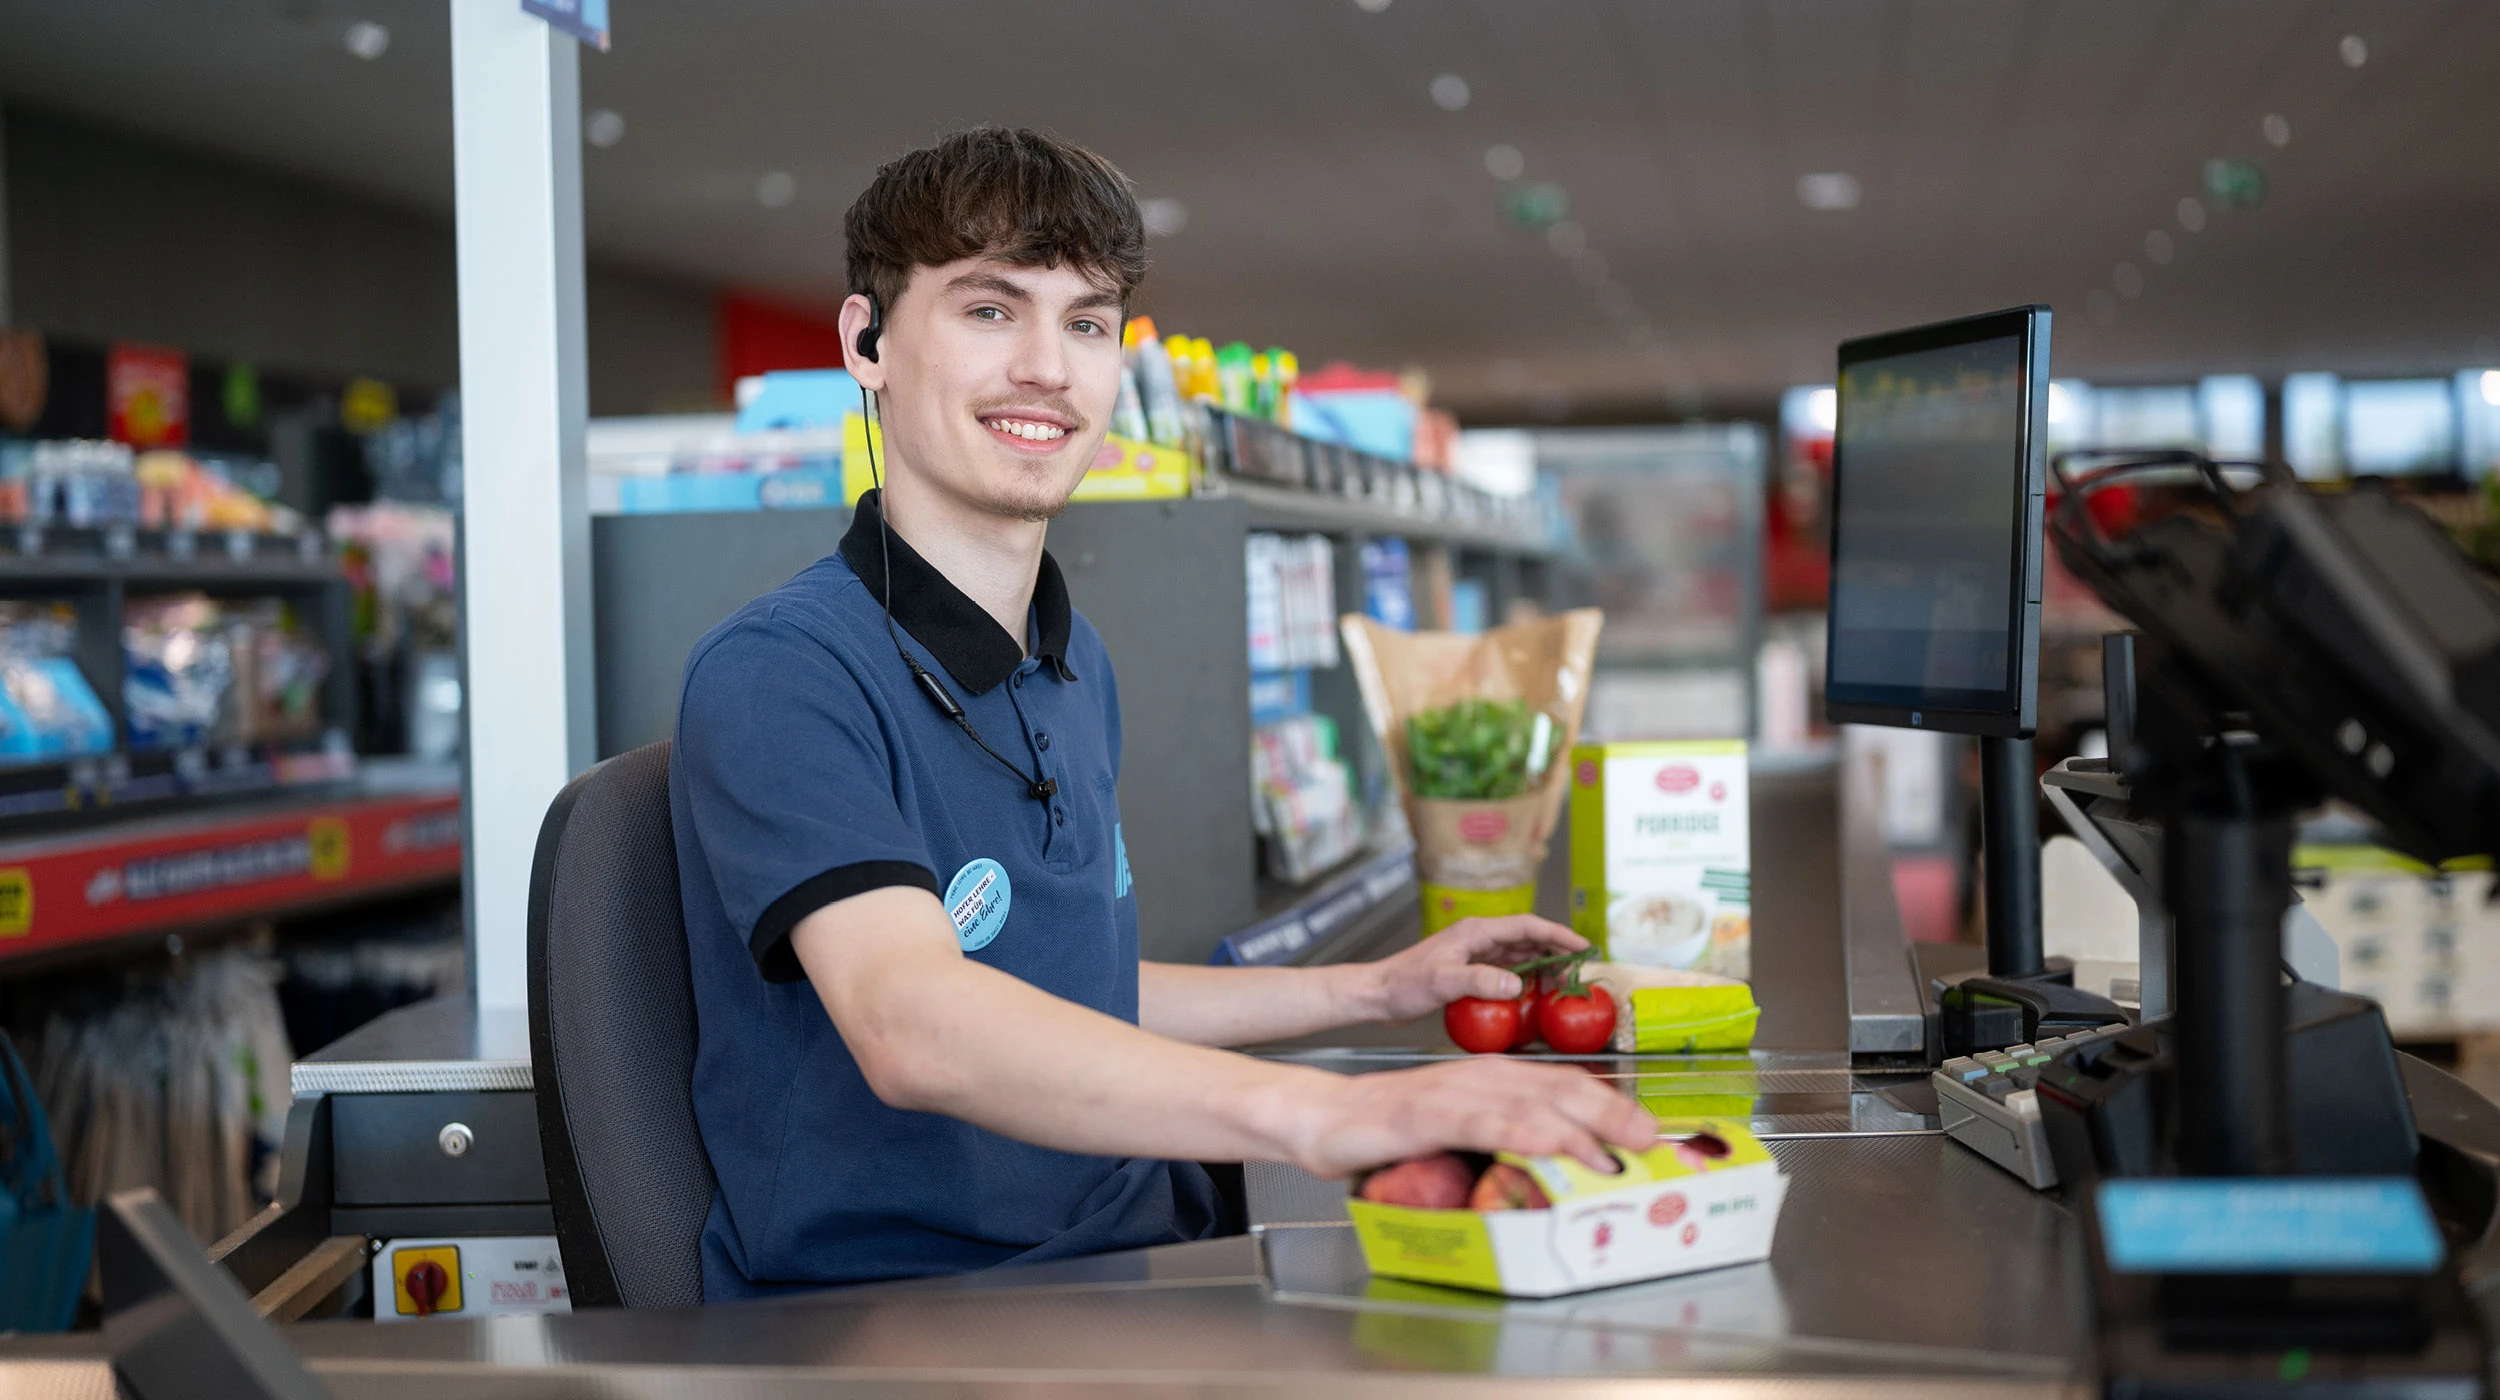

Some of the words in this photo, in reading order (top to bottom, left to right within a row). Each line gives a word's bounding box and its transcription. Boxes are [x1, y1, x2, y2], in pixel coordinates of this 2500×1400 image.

[953, 895, 973, 918] HOFER
[972, 877, 991, 898] LEHRE
[958, 911, 972, 926] WAS
[971, 899, 984, 913] FÜR
[963, 919, 980, 938] eine
[979, 890, 1003, 921] Ehre!
